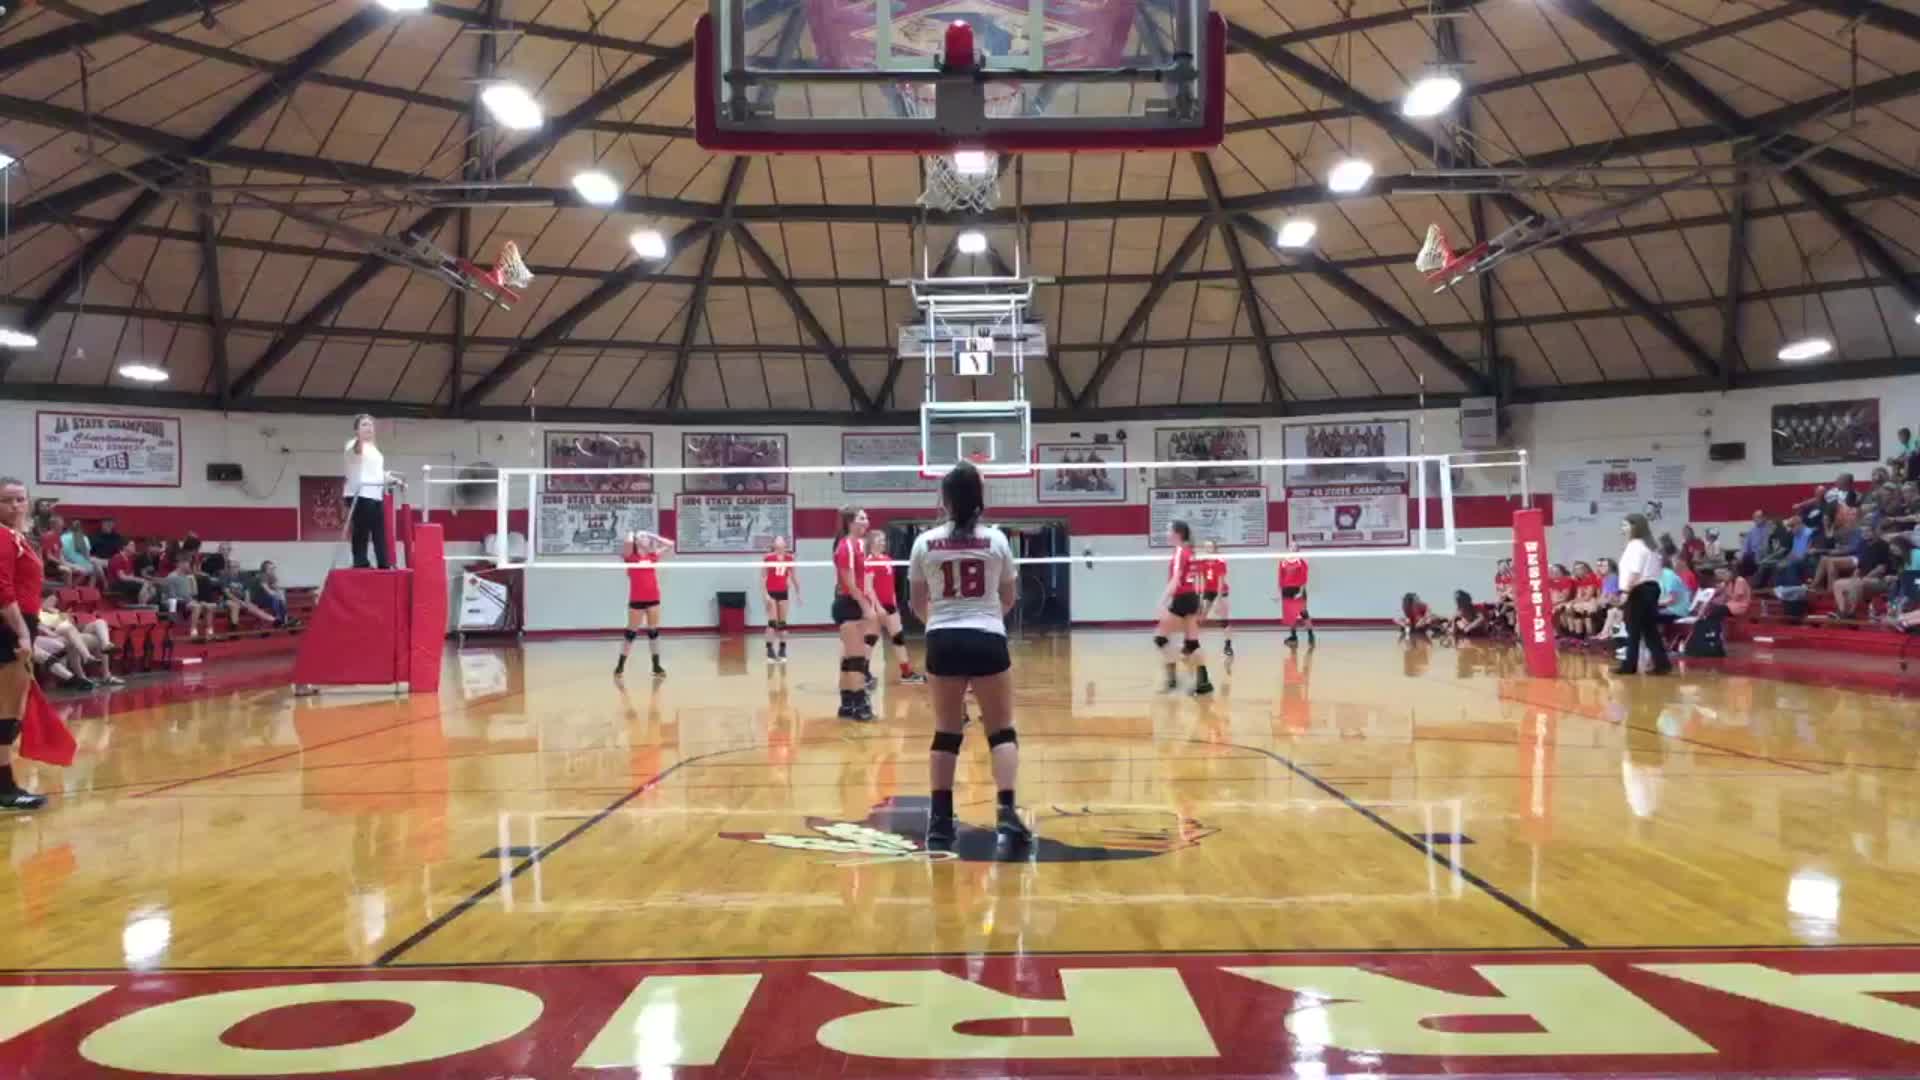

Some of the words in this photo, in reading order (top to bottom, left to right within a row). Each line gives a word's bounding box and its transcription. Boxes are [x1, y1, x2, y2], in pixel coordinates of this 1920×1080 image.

[72, 418, 104, 430] STATE
[107, 419, 164, 438] CHAMPIONS
[1175, 490, 1204, 499] STATE
[1206, 489, 1261, 499] CHAMPIONS
[1326, 487, 1350, 497] STATE
[1353, 485, 1402, 496] CHAMPIONS
[566, 495, 595, 504] STATE
[599, 495, 653, 505] CHAMPIONS
[704, 496, 732, 505] STATE
[736, 495, 788, 505] CHAMPIONS
[941, 559, 985, 598] 18
[1524, 541, 1546, 643] WESTSIDE
